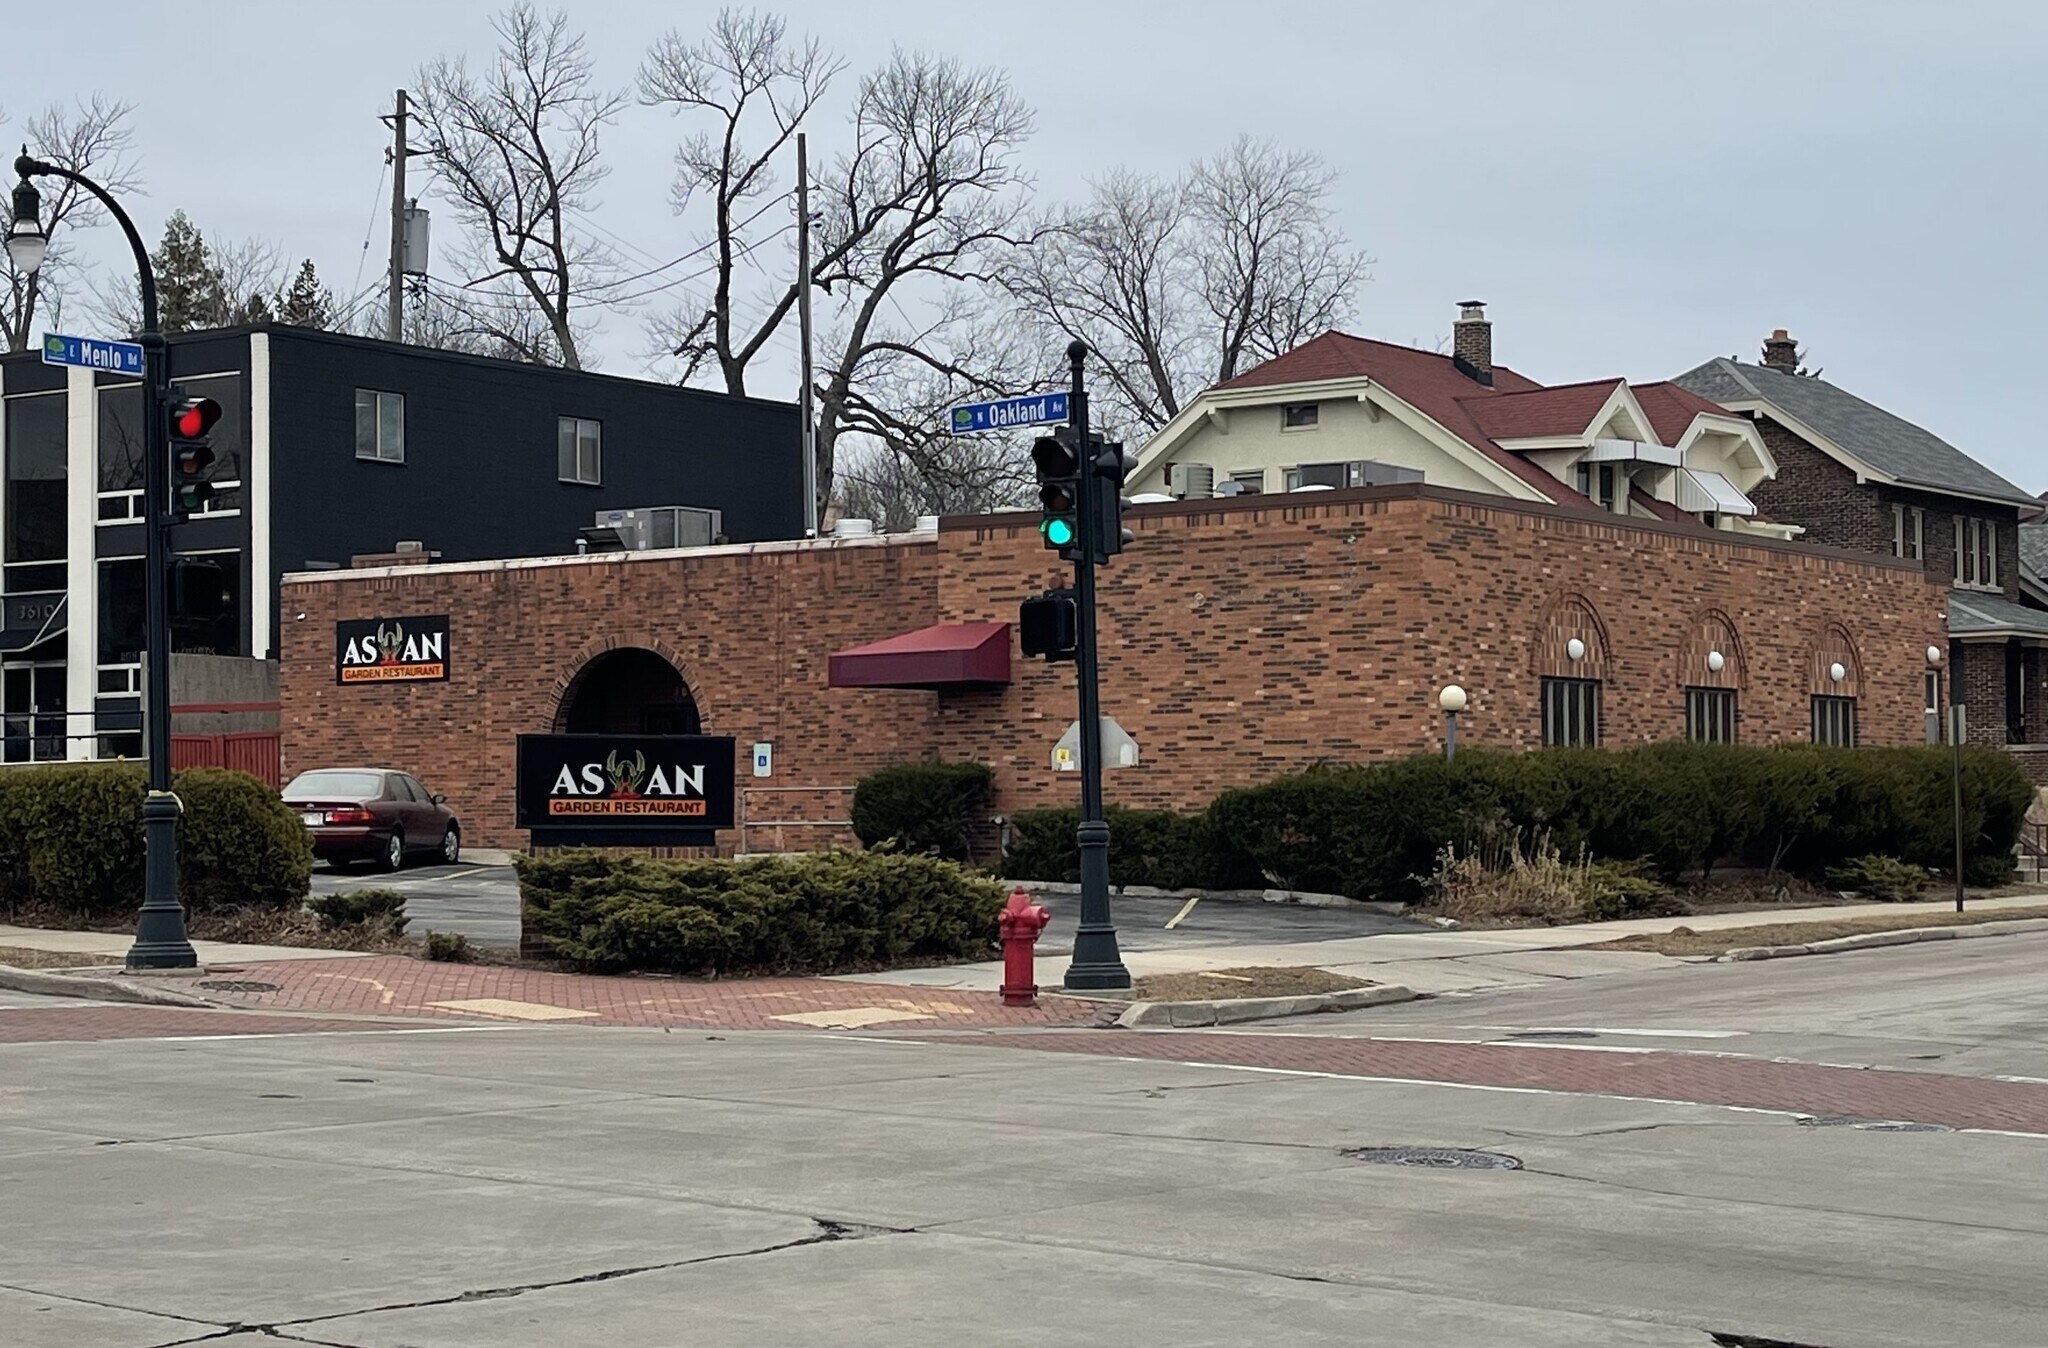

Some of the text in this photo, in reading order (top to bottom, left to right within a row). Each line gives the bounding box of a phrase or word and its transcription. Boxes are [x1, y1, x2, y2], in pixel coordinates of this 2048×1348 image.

[69, 344, 75, 357] E
[81, 341, 122, 369] Menlo
[127, 352, 138, 366] Rd
[977, 398, 1064, 426] N Oakland Av
[342, 629, 444, 665] ASAN
[344, 665, 441, 680] GARDEN RESTAURANT
[550, 755, 706, 796] ASAN
[553, 801, 702, 814] GARDEN RESTAURANT
